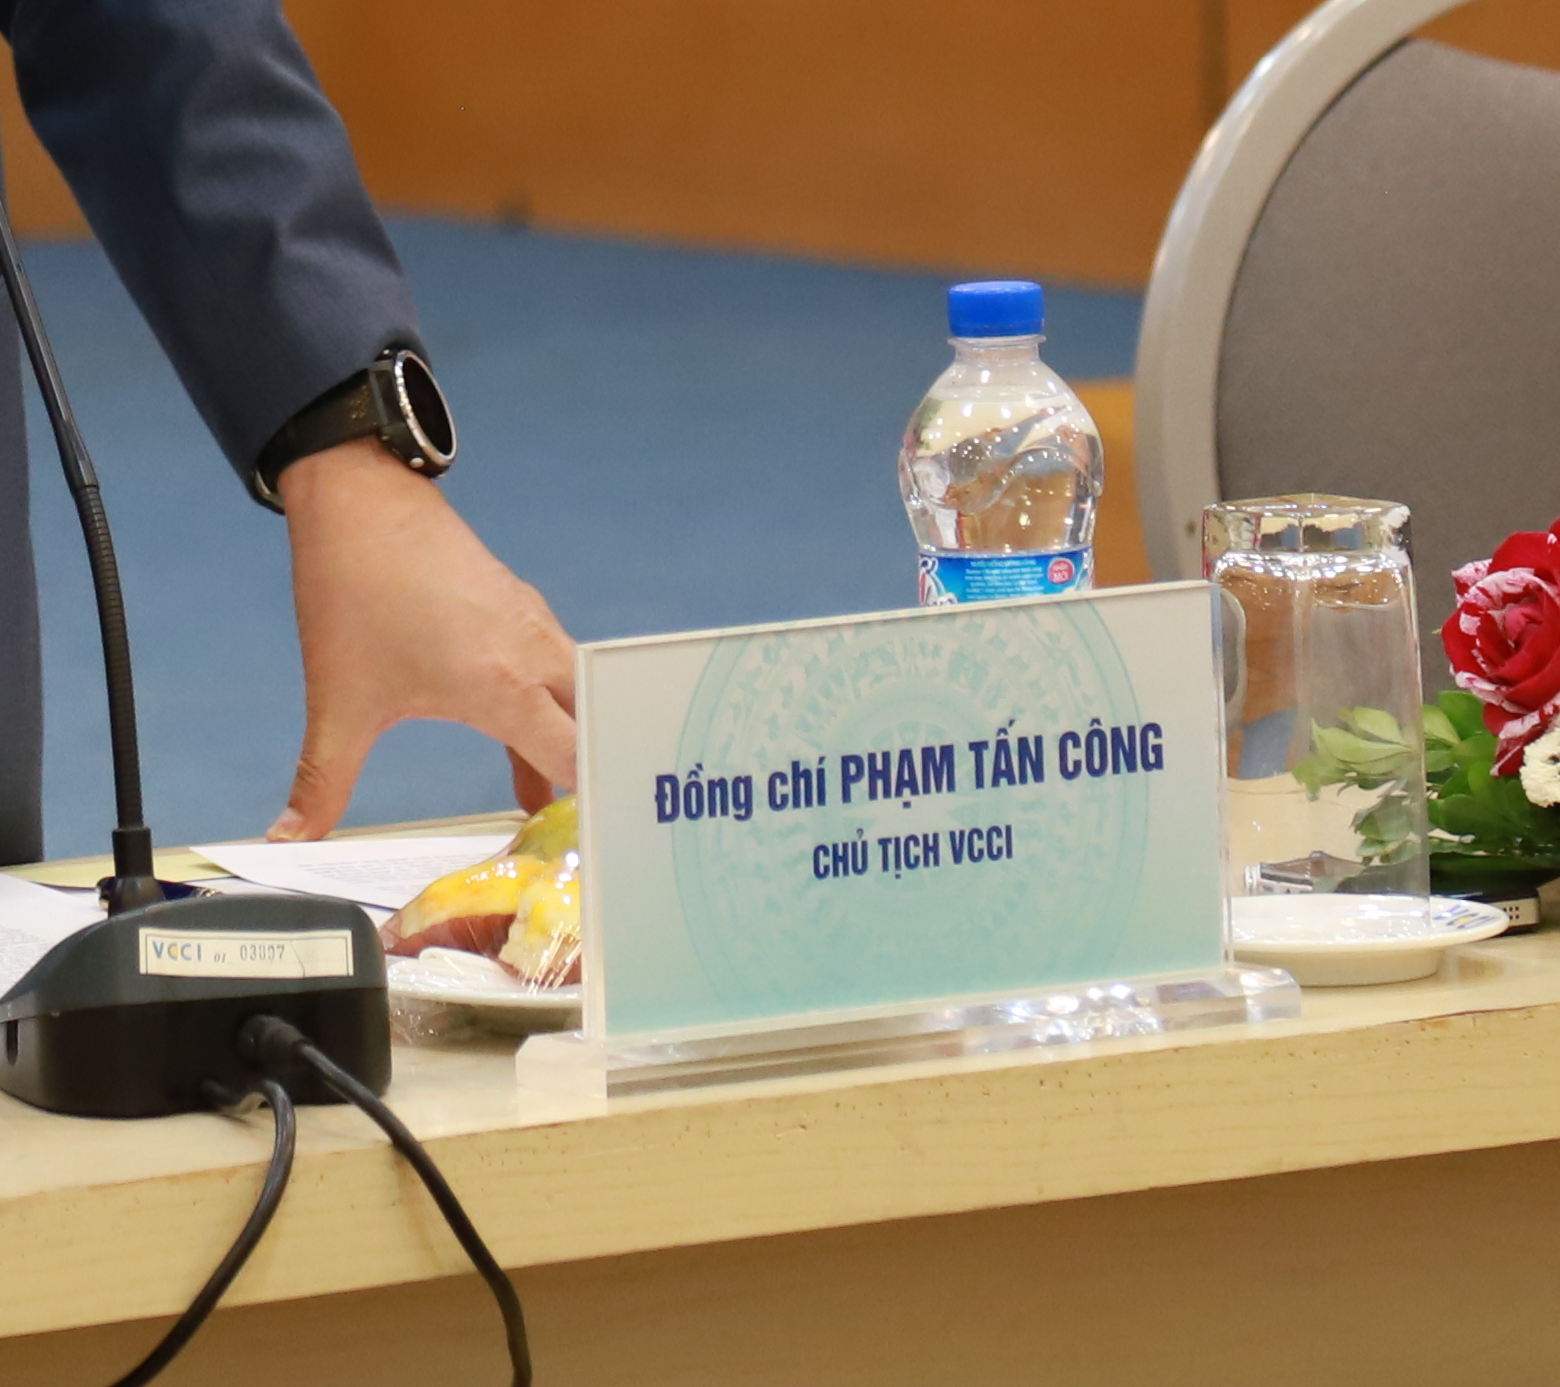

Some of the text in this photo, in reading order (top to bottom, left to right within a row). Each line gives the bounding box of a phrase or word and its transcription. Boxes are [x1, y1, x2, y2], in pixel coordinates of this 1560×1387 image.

[655, 718, 1164, 824] Đồng chí PHẠM TẤN CÔNG
[813, 824, 1013, 879] CHỦ TỊCH VCCI
[152, 941, 202, 961] VCCI
